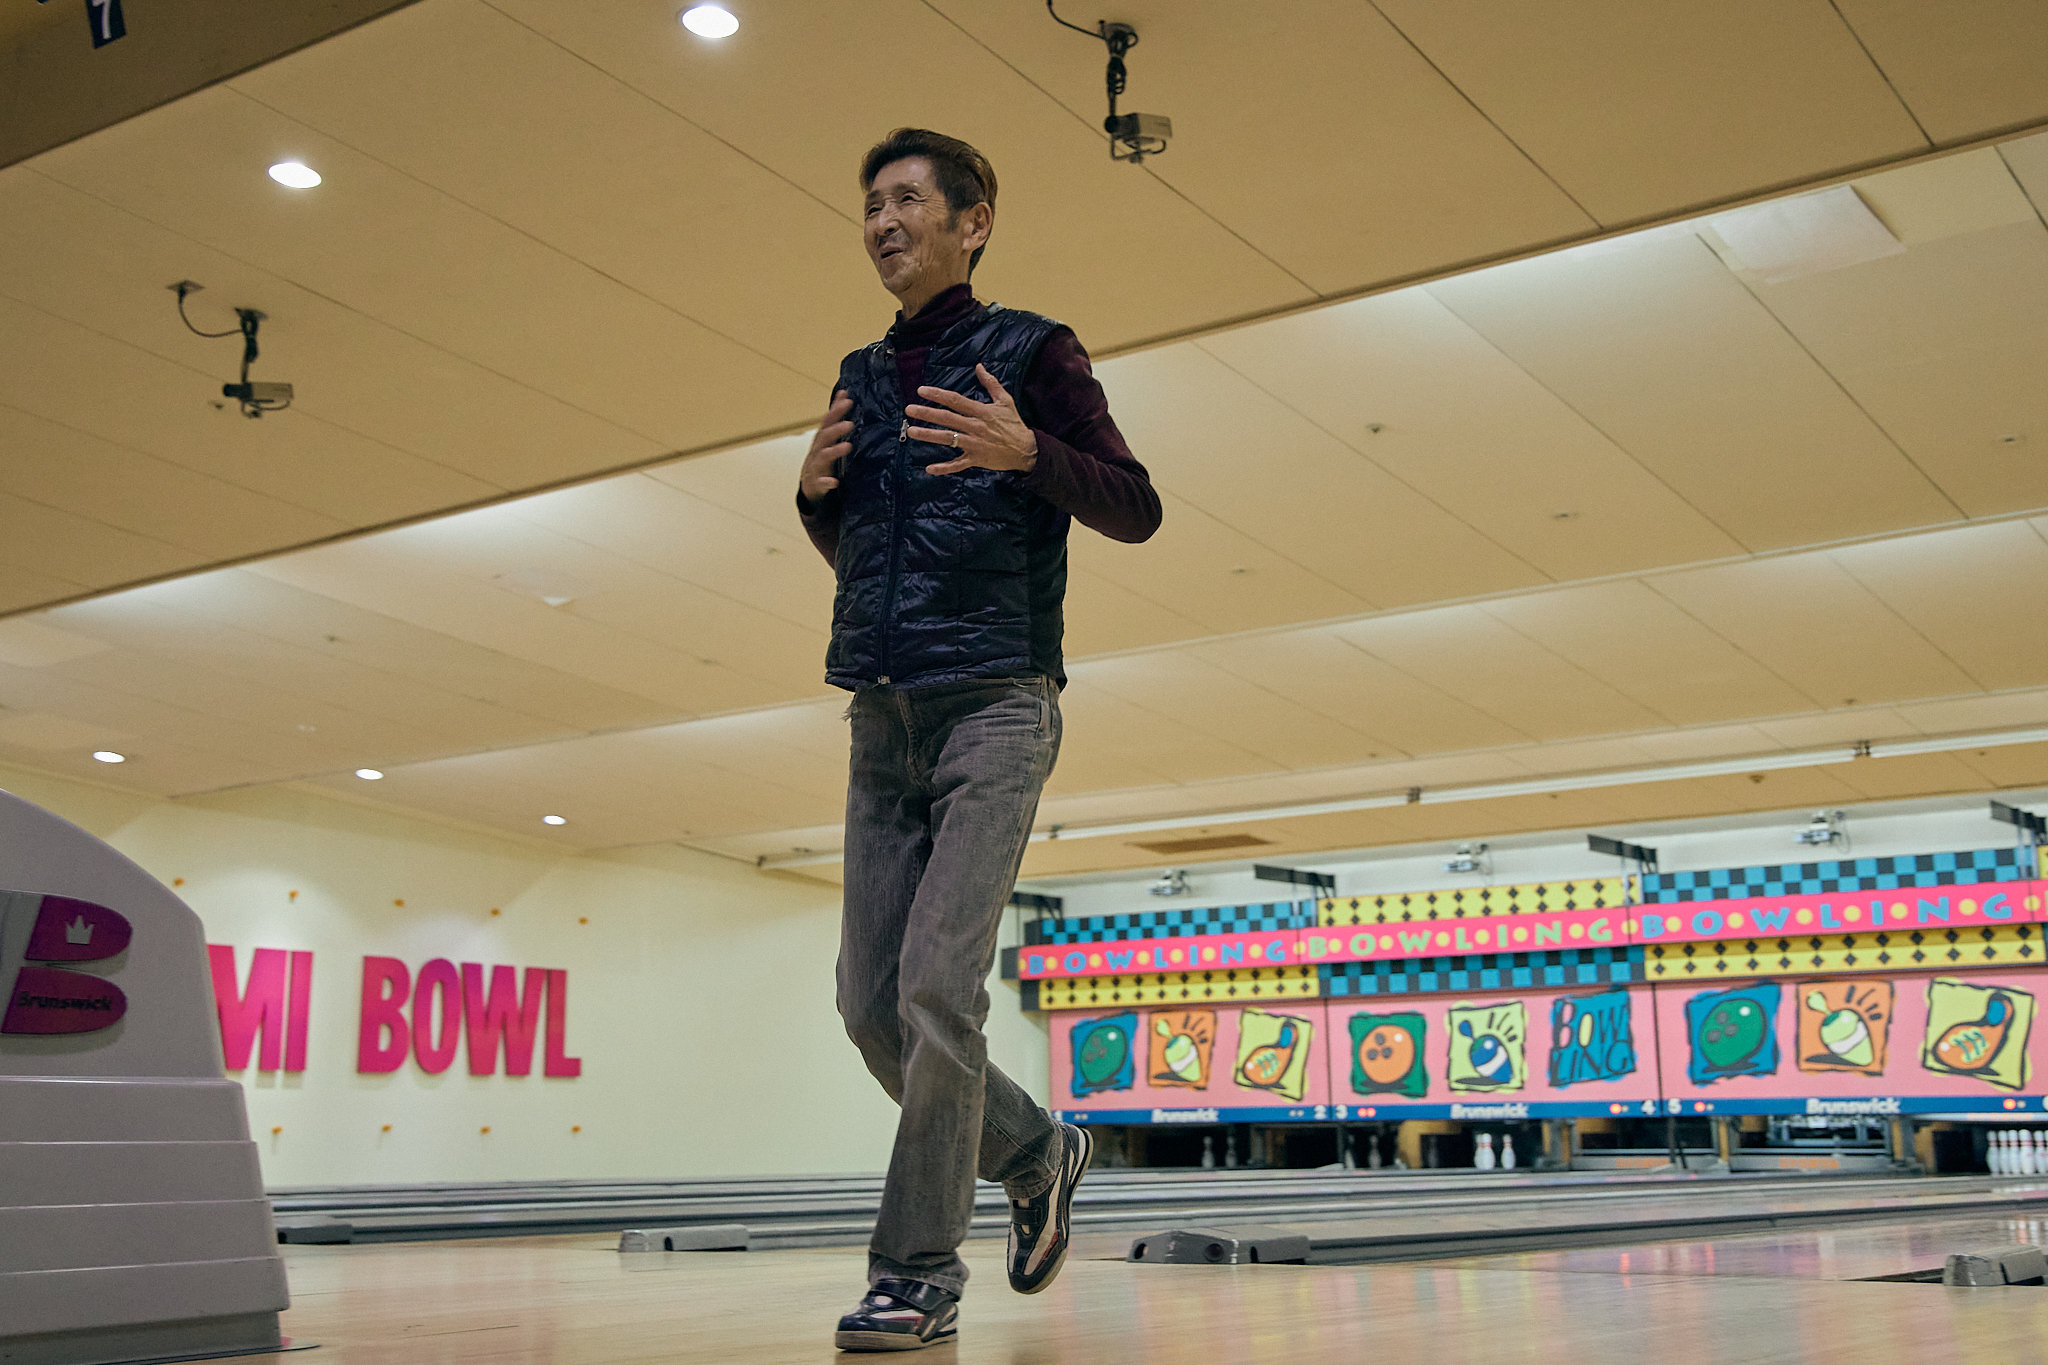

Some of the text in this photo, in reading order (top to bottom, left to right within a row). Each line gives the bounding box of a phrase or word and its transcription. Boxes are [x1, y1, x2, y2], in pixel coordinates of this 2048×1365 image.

[1642, 892, 2013, 939] BOWLING
[1308, 918, 1613, 958] BOWLING
[1028, 940, 1286, 975] BOWLING
[356, 954, 582, 1078] BOWL
[1314, 1104, 1327, 1120] 2
[1335, 1104, 1348, 1120] 3
[1641, 1099, 1656, 1116] 4
[1805, 1096, 1901, 1115] Brunswick
